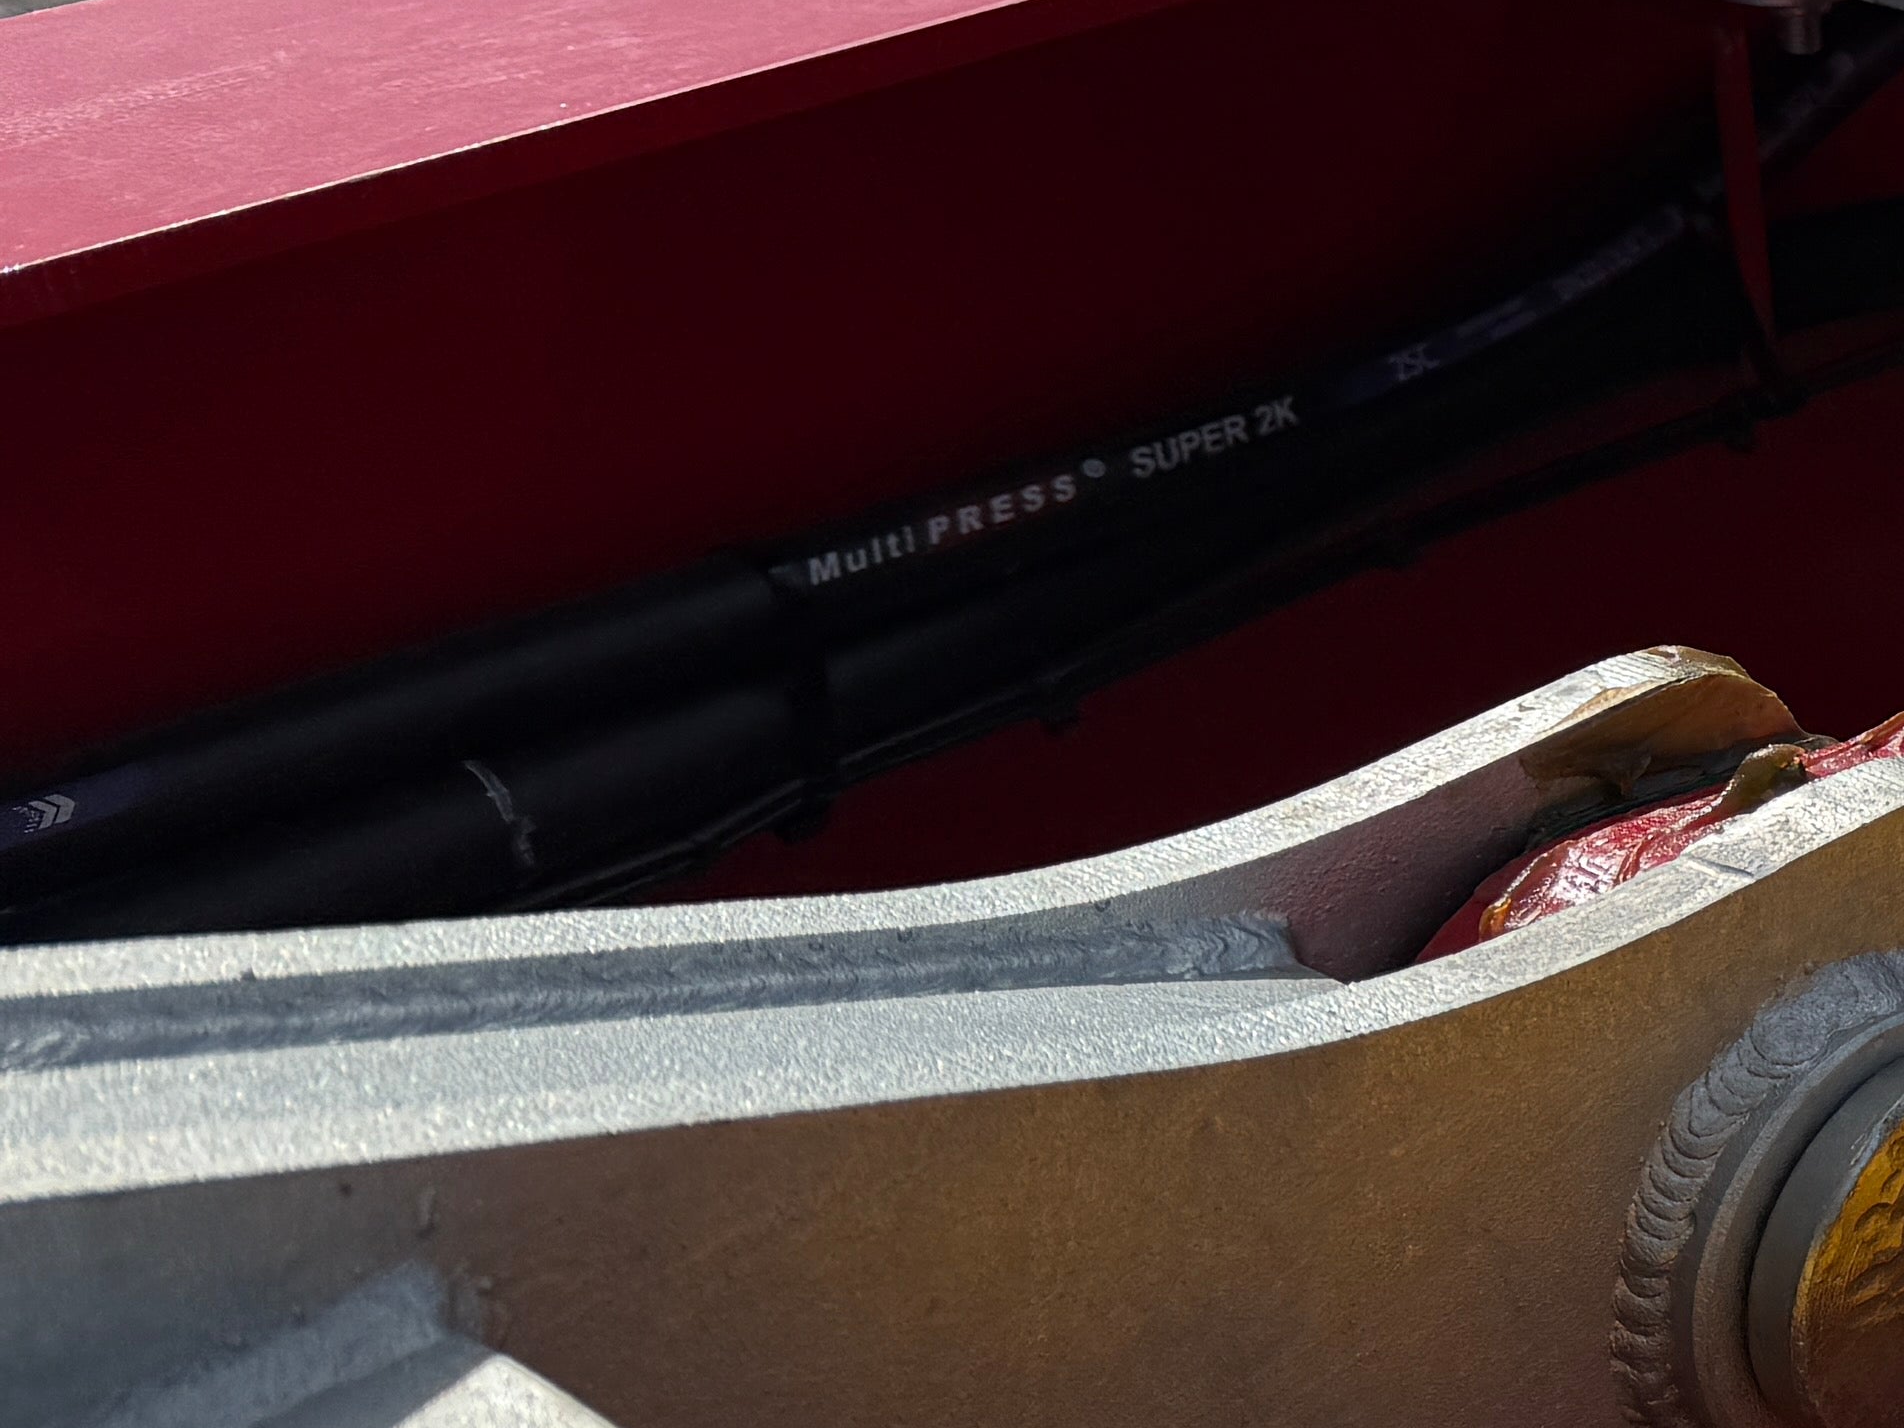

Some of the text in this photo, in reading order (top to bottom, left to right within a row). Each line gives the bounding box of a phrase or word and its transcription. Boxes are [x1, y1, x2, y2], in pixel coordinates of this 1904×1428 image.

[807, 525, 916, 585] Multi
[1129, 413, 1248, 479] SUPER
[1253, 395, 1299, 437] 2K
